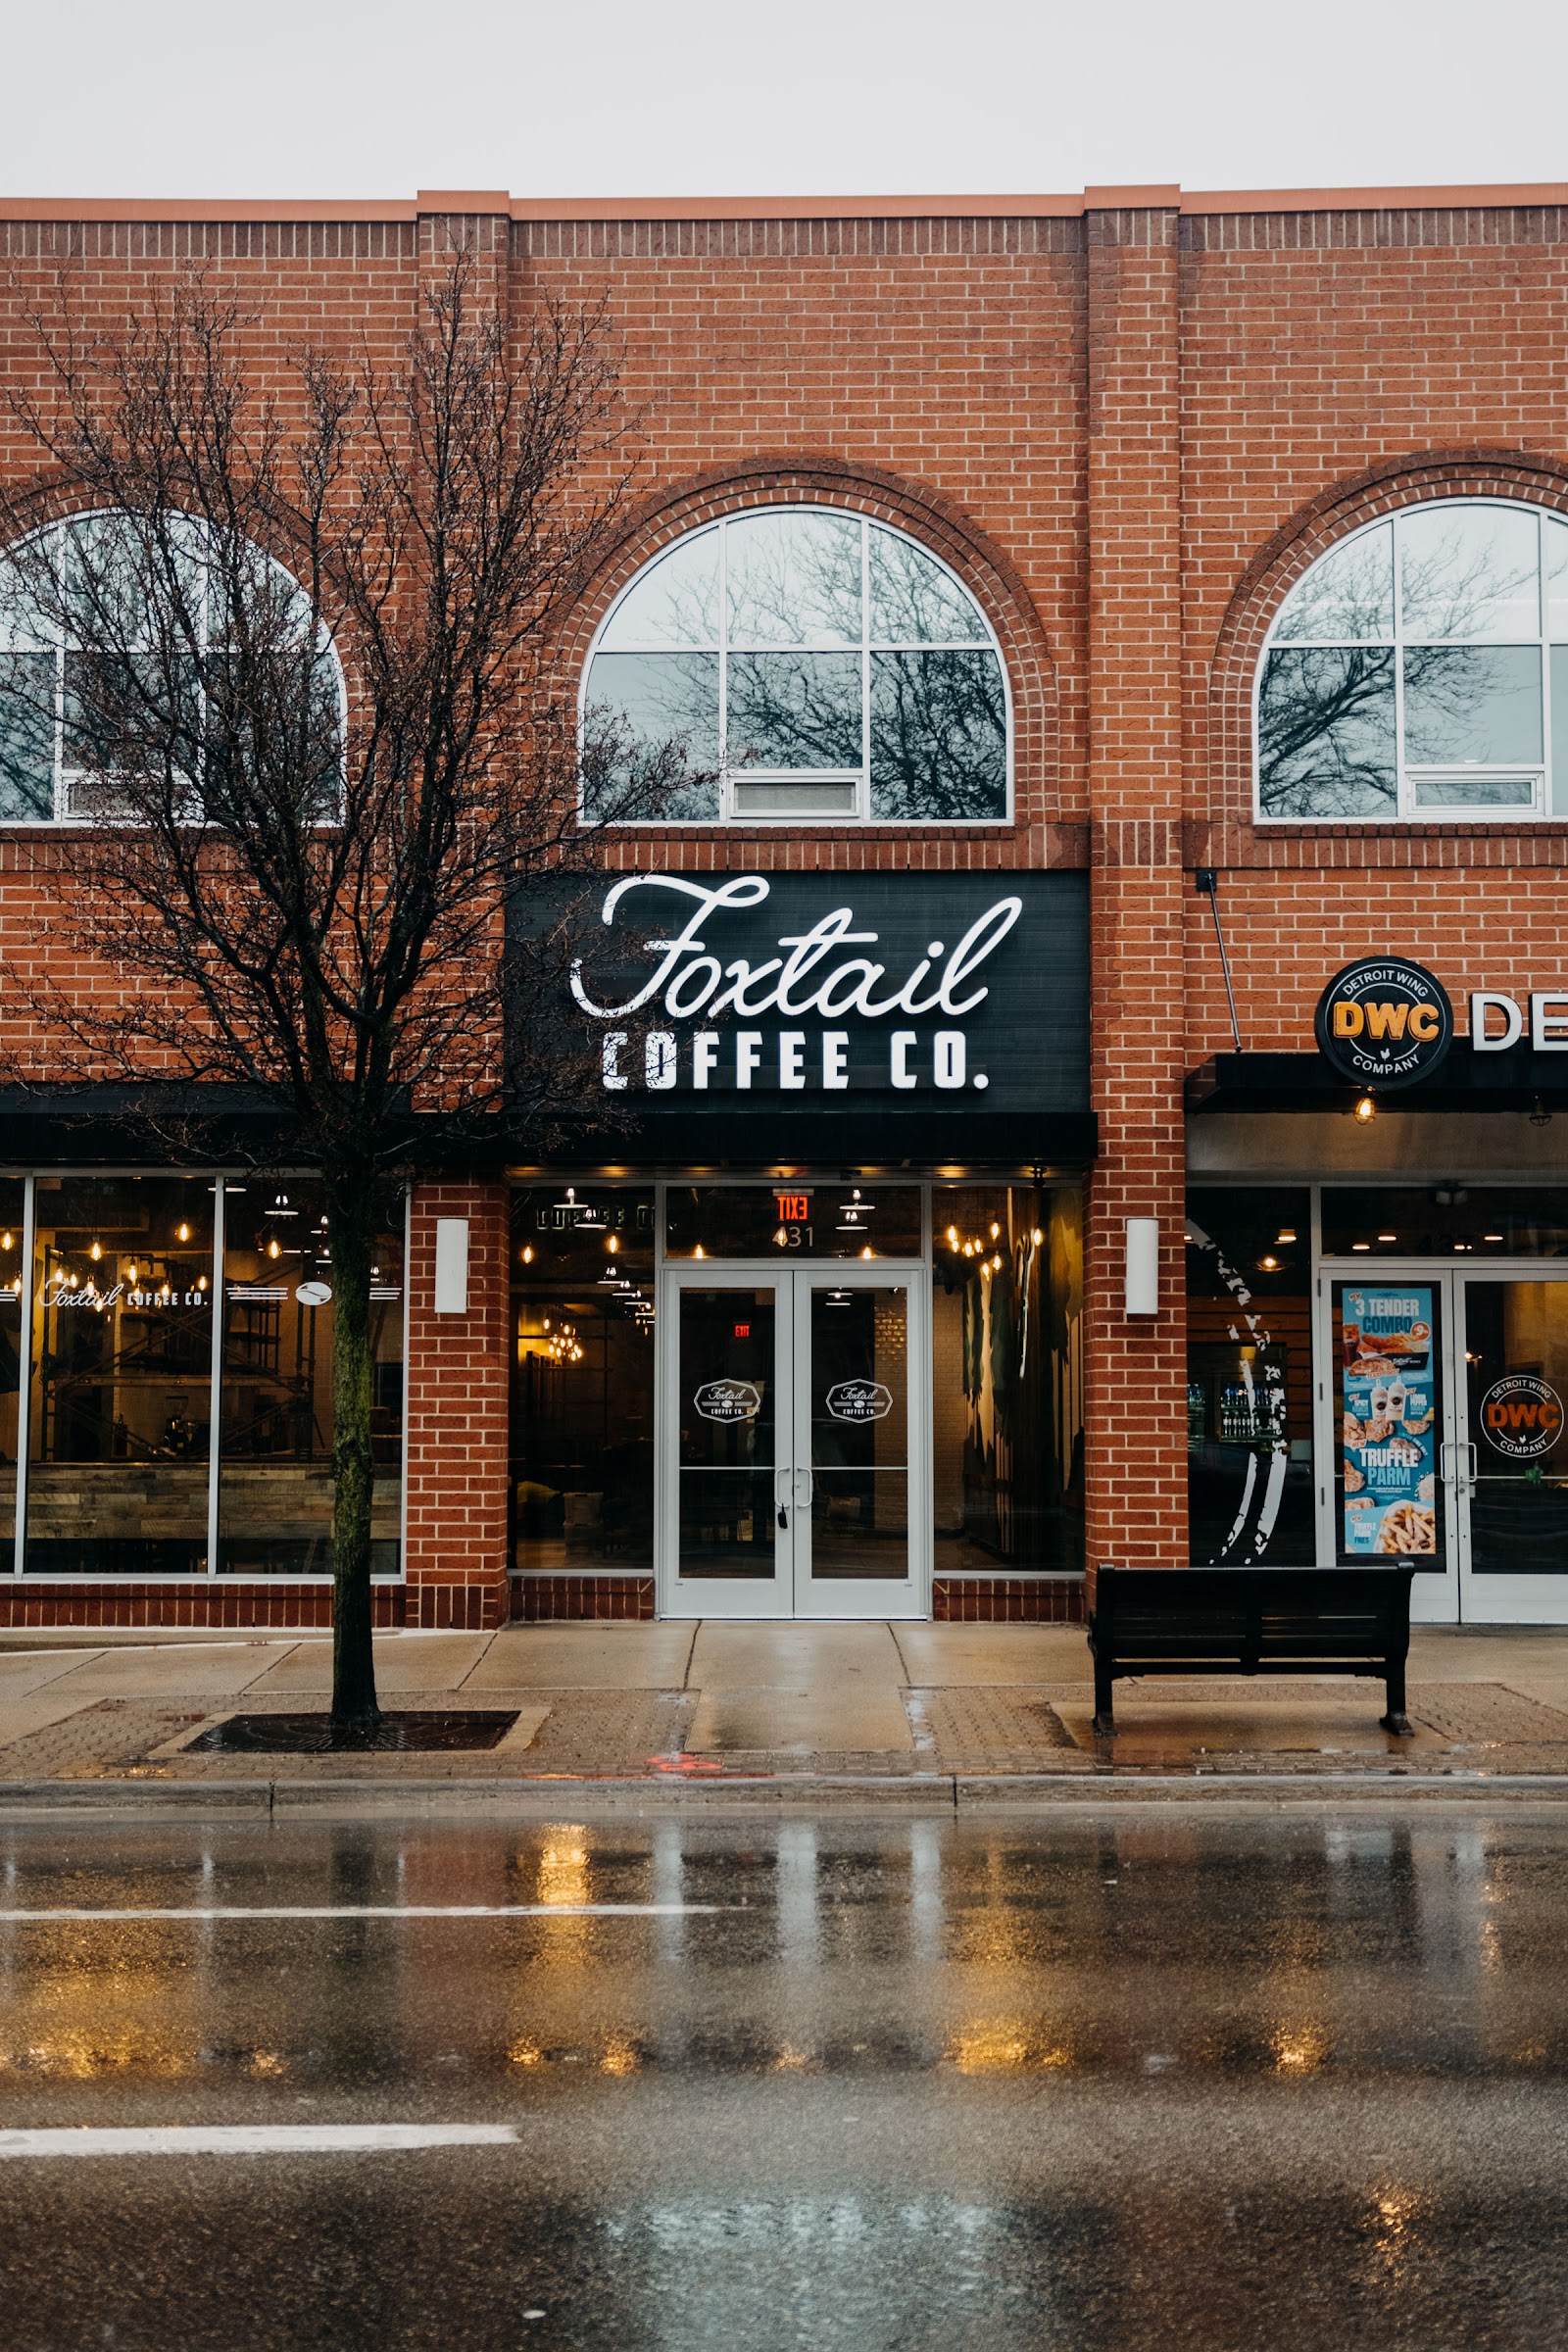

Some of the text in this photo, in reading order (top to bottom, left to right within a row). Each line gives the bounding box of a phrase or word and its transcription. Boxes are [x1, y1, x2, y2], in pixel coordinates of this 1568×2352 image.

[569, 873, 1022, 1018] Foxtail
[1342, 969, 1429, 999] DETROIT WING
[1333, 1001, 1440, 1043] DWC
[602, 1031, 989, 1090] COFFEE CO.
[1352, 1053, 1421, 1075] COMPANY
[38, 1278, 209, 1307] Foxtail COFFEE CO.
[1354, 1298, 1419, 1316] 3 TENDER
[735, 1325, 750, 1338] EXIT
[1362, 1316, 1413, 1333] COMBO
[708, 1387, 747, 1400] Foxtail
[840, 1387, 878, 1400] Foxtail
[1492, 1380, 1552, 1398] DETROIT WING
[1487, 1403, 1559, 1429] DWC
[1499, 1438, 1547, 1453] COMPANY
[1359, 1447, 1419, 1467] TRUFFLE
[1367, 1467, 1411, 1486] PARM
